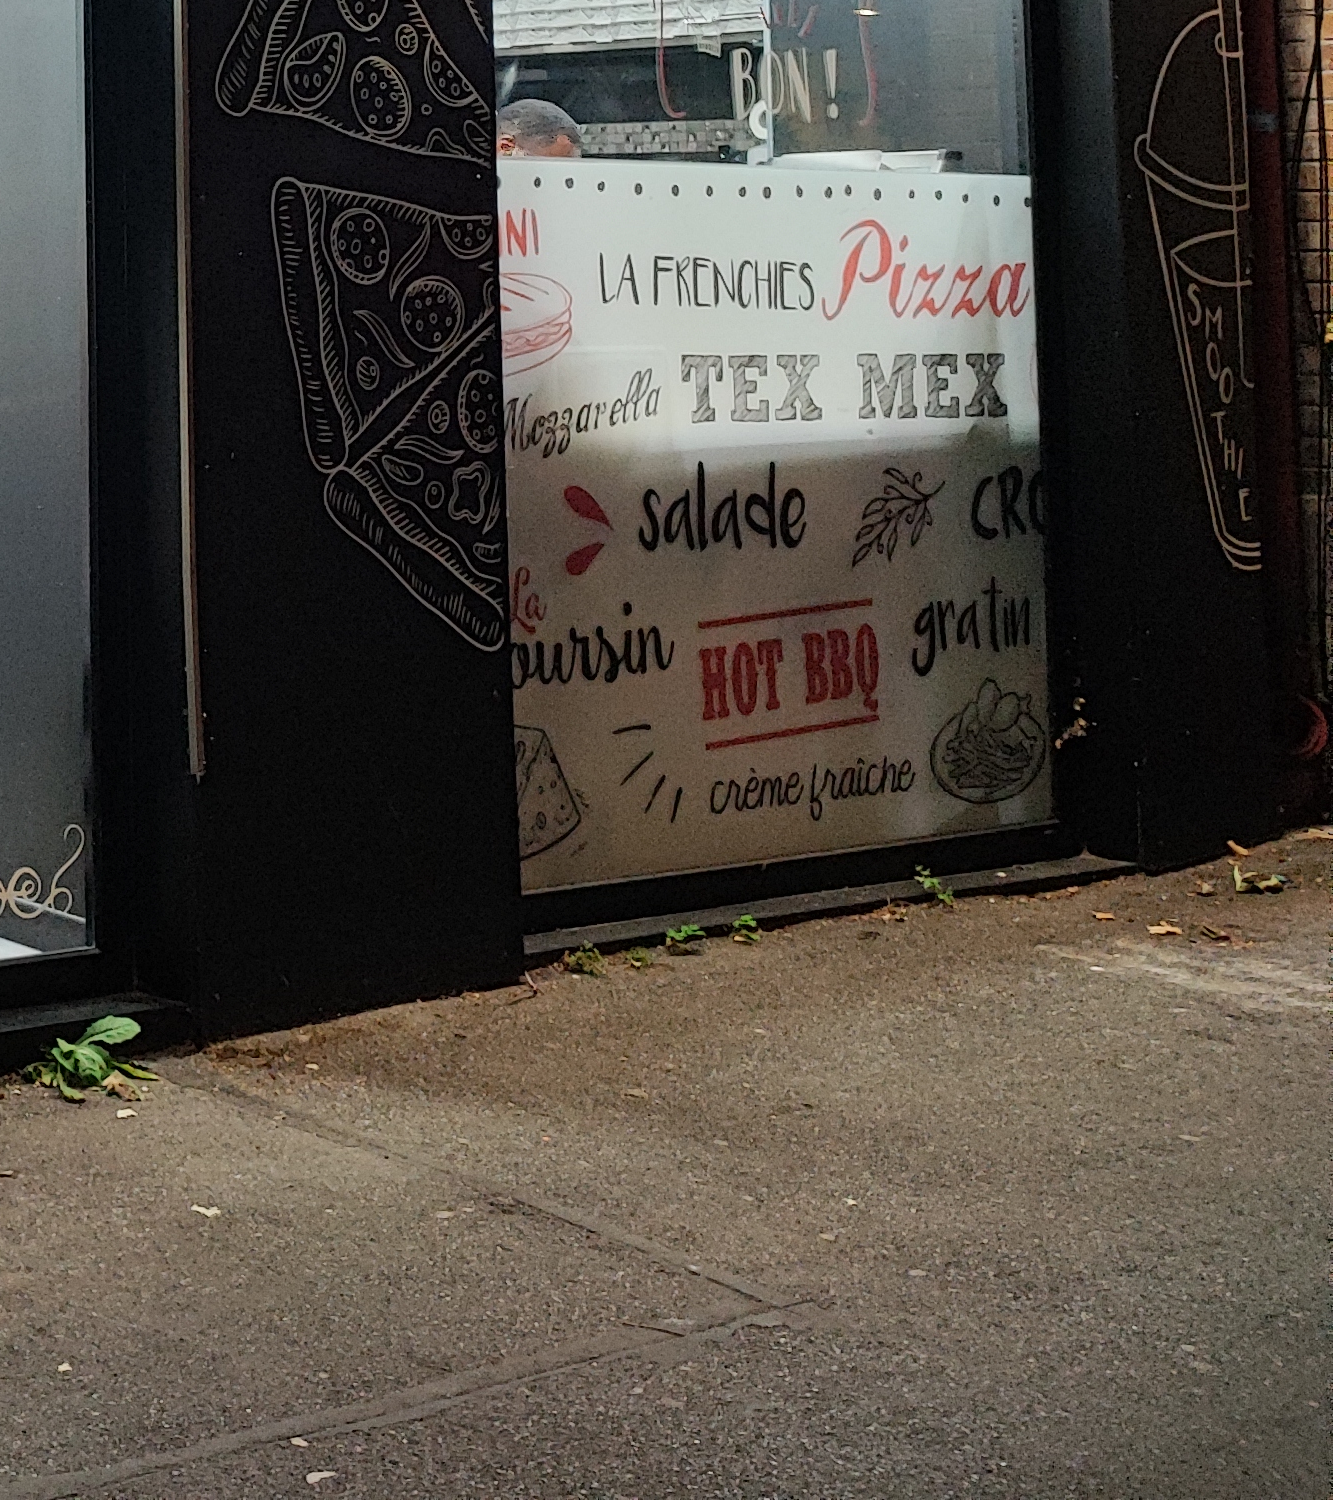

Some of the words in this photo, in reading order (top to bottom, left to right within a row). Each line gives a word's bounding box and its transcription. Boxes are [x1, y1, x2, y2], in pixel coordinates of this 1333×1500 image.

[729, 46, 811, 124] BON
[498, 208, 539, 257] NI
[821, 219, 1031, 320] Pizza
[599, 252, 639, 306] LA
[653, 255, 815, 311] FRENCHIES
[504, 370, 662, 458] Mozzarella
[681, 353, 823, 424] TEX
[857, 353, 1008, 419] MEX
[638, 461, 807, 551] salade
[510, 601, 675, 689] oursin
[913, 576, 1030, 675] gratin
[699, 639, 784, 722] HOT
[802, 624, 880, 710] BBQ
[710, 771, 803, 814] crème
[807, 755, 916, 821] fraîche
